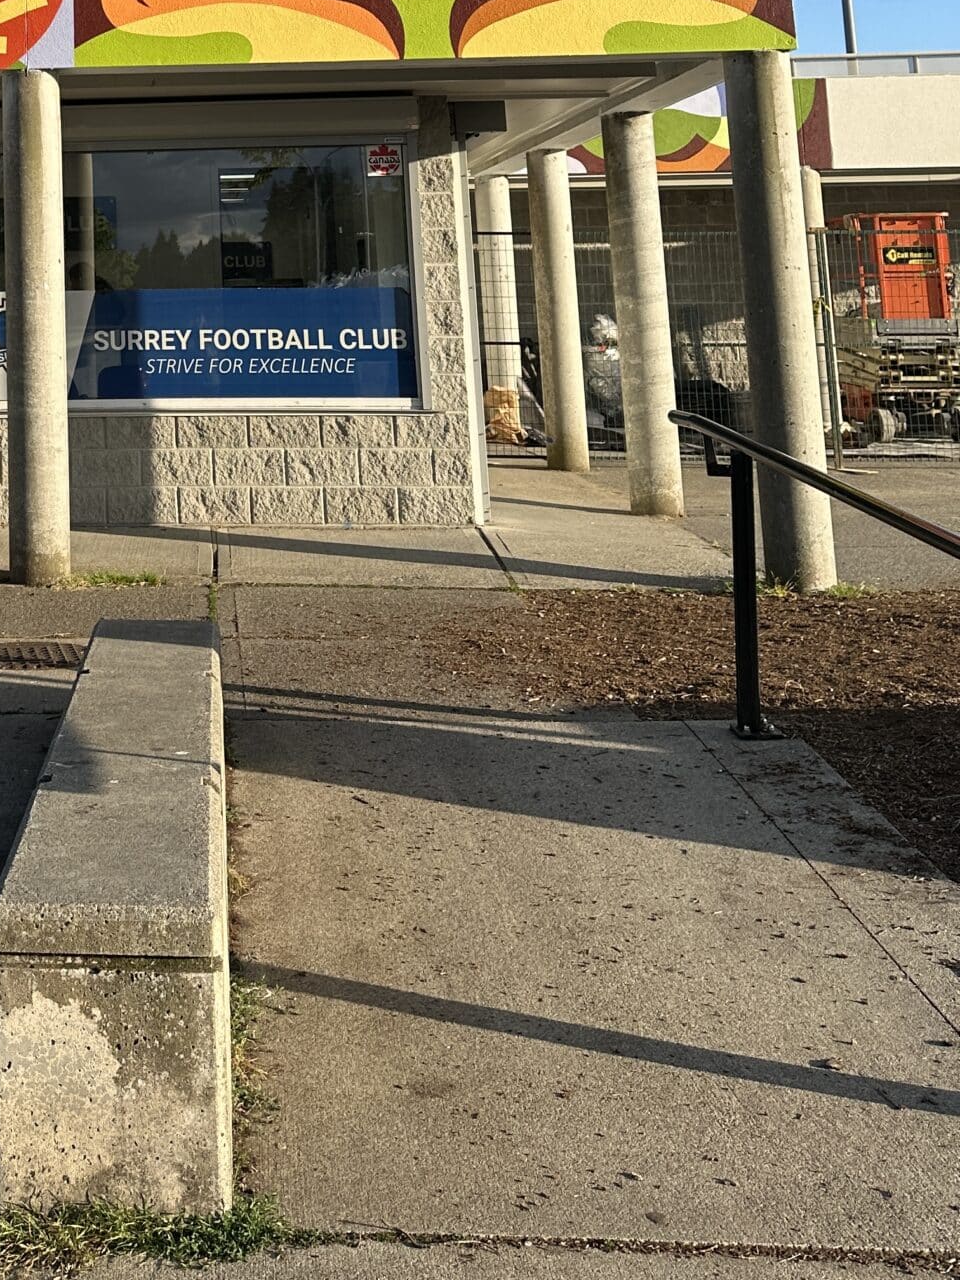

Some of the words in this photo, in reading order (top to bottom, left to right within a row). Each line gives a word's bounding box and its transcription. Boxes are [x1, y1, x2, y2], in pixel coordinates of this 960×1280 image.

[224, 255, 266, 268] CLUB
[93, 329, 192, 352] SURREY
[199, 328, 333, 351] FOOTBALL
[339, 328, 408, 350] CLUB
[145, 358, 204, 374] STRIVE
[208, 358, 243, 374] FOR
[248, 357, 356, 374] EXCELLENCE
